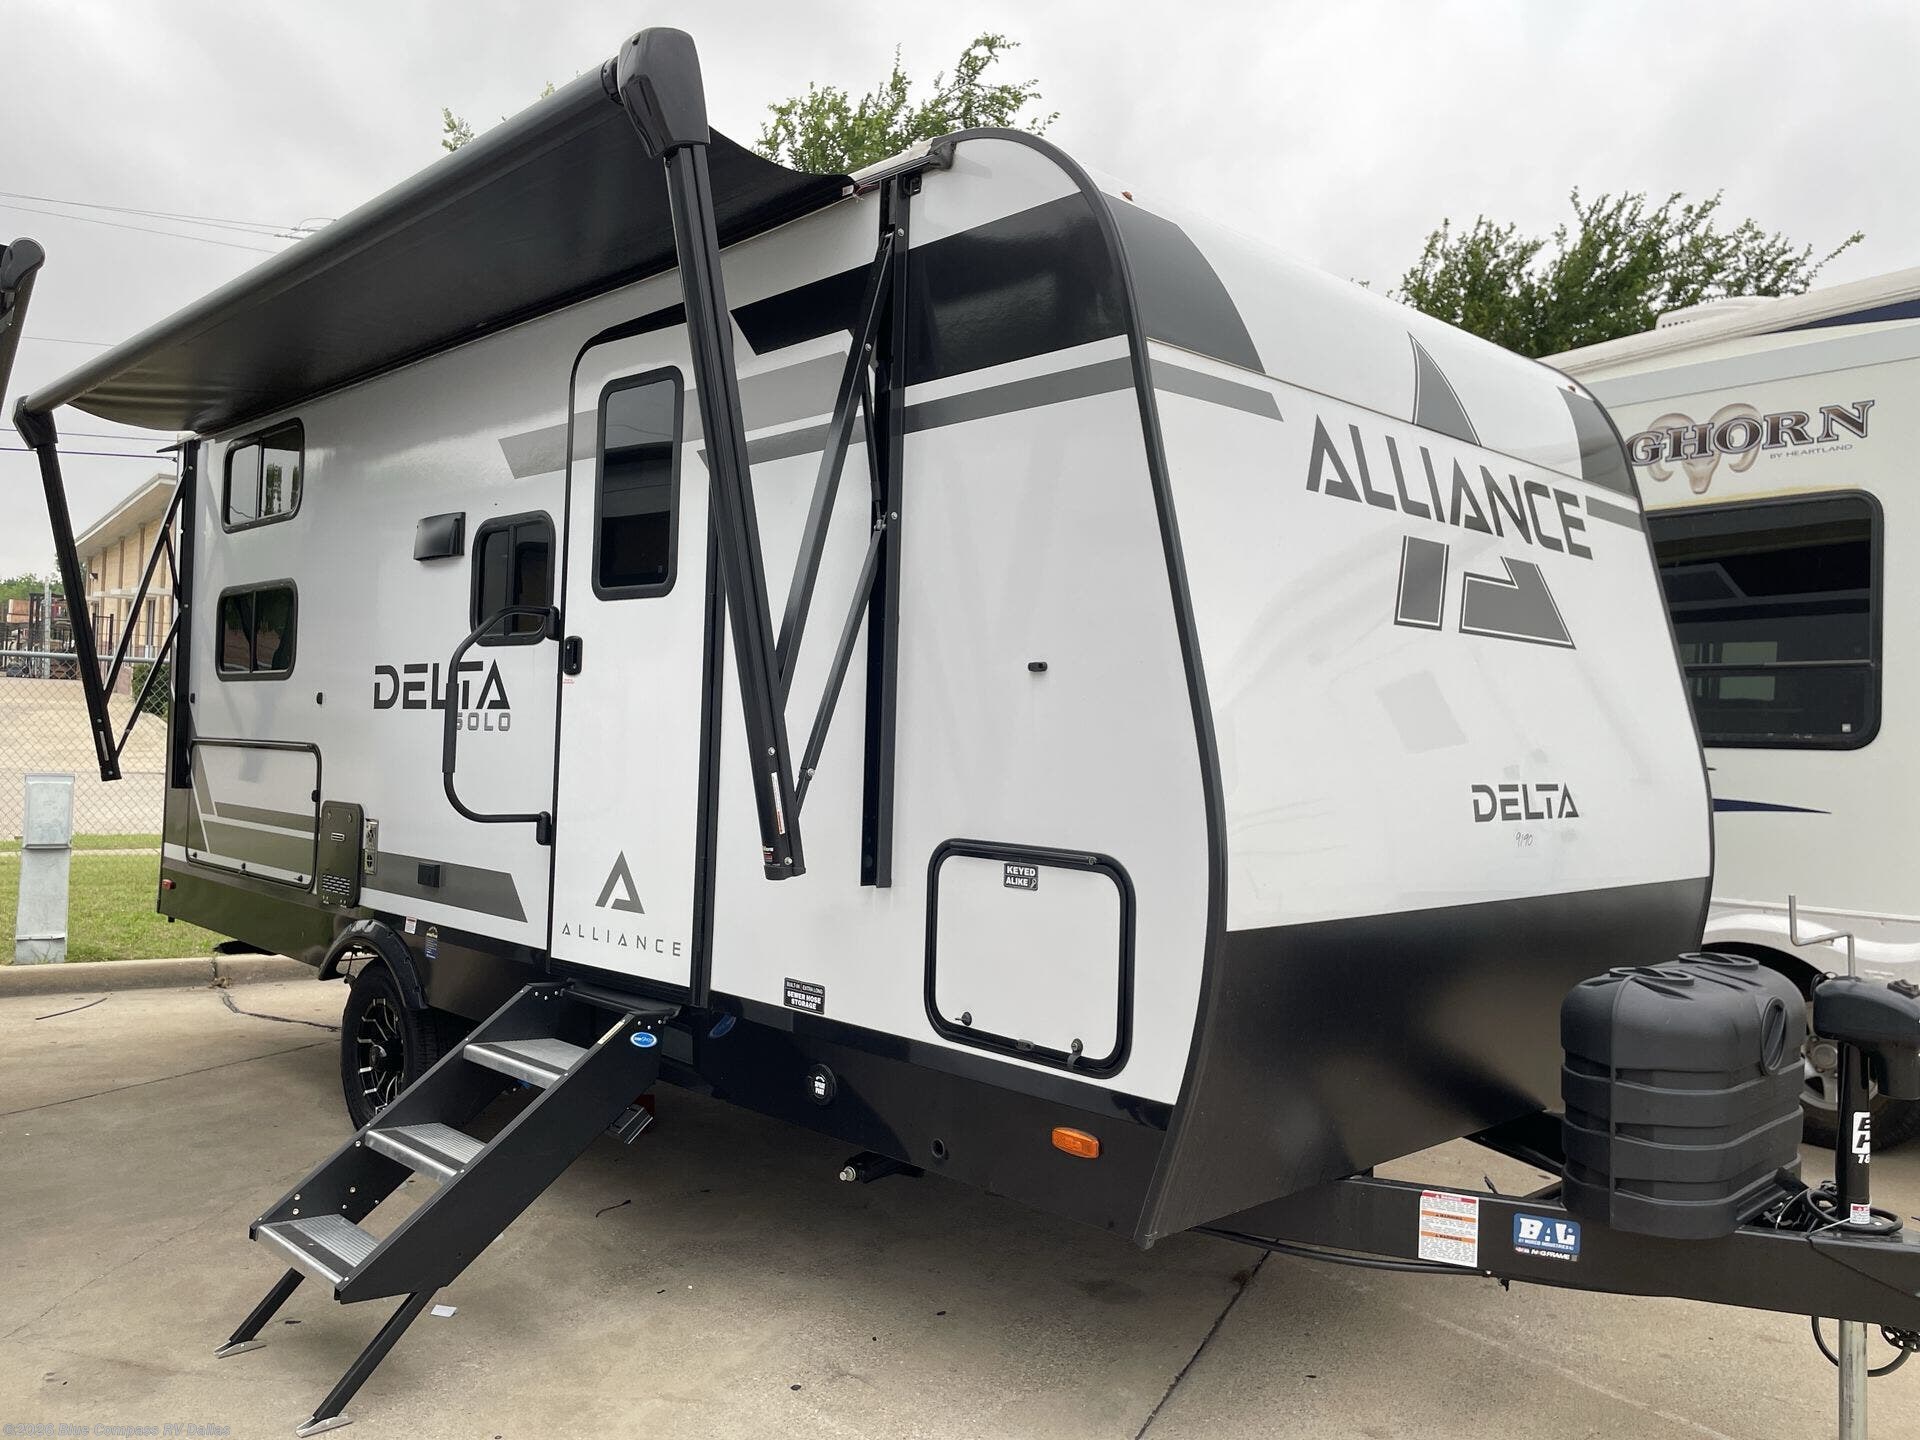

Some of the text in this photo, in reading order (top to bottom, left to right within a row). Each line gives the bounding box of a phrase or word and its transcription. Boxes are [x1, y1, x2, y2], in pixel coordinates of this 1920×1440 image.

[1786, 444, 1853, 457] HEARTLAND
[1306, 413, 1594, 560] ALLIANCE
[373, 659, 511, 710] DELTA
[1471, 783, 1580, 823] DELTA
[1006, 865, 1036, 877] KEYED
[1006, 876, 1029, 887] ALIKE
[562, 922, 681, 957] ALLIANCE
[787, 990, 822, 1005] SEWER HOSE
[791, 998, 817, 1010] STORAGE
